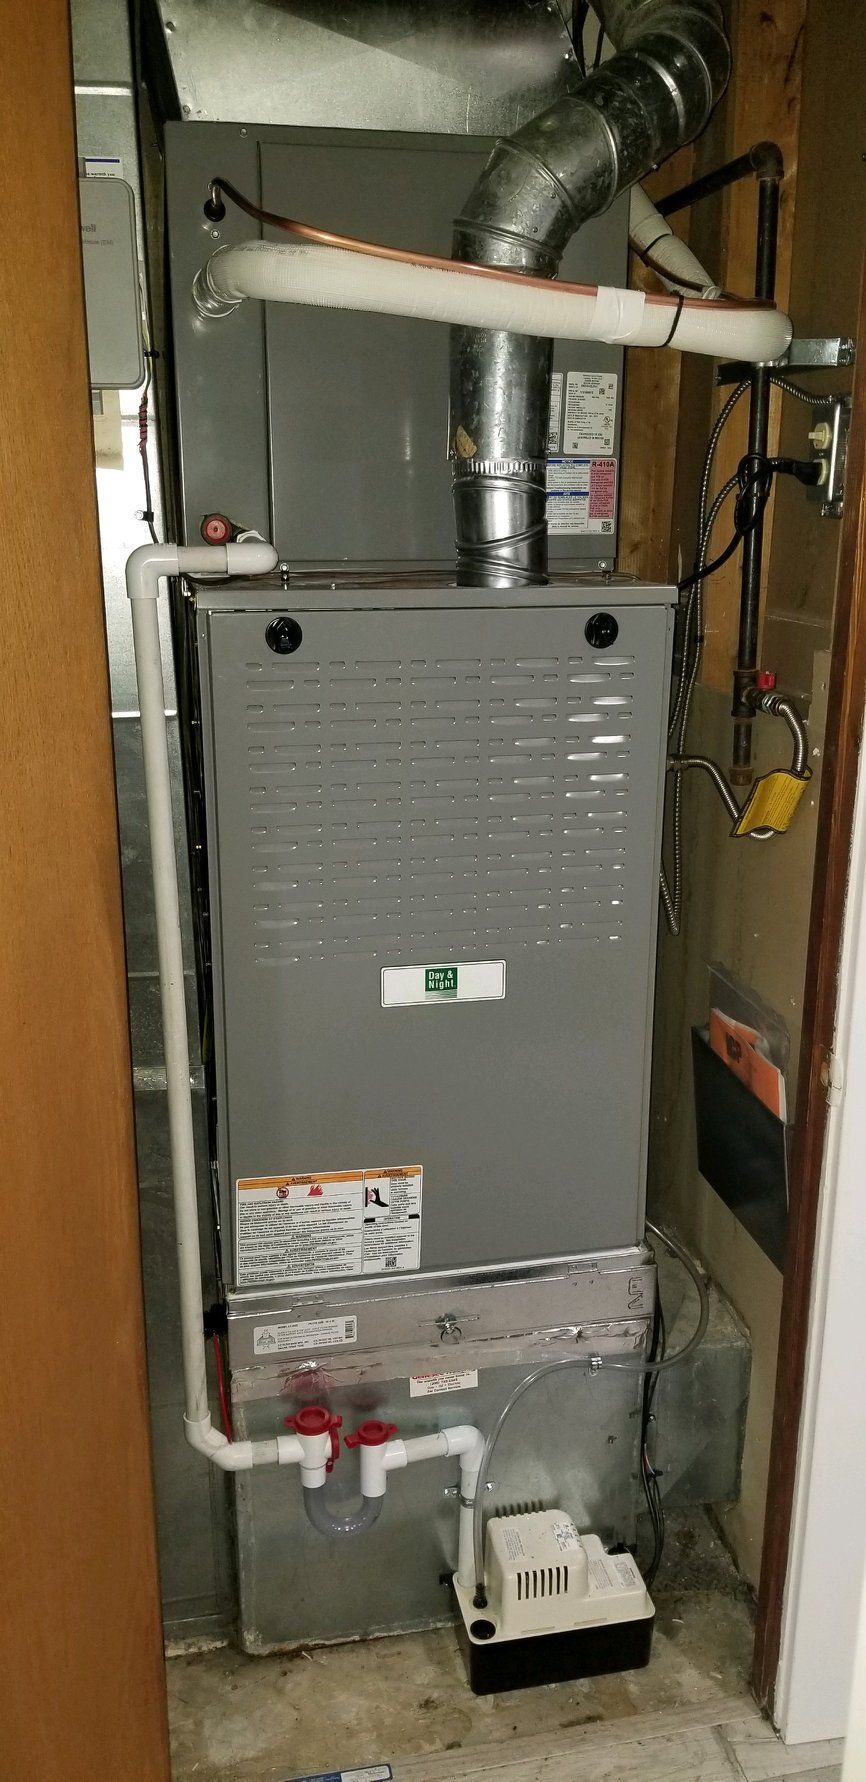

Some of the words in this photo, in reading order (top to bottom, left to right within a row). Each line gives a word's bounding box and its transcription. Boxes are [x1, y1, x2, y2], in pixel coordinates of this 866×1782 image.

[429, 971, 444, 980] Day
[447, 970, 453, 978] &
[429, 980, 453, 989] Night
